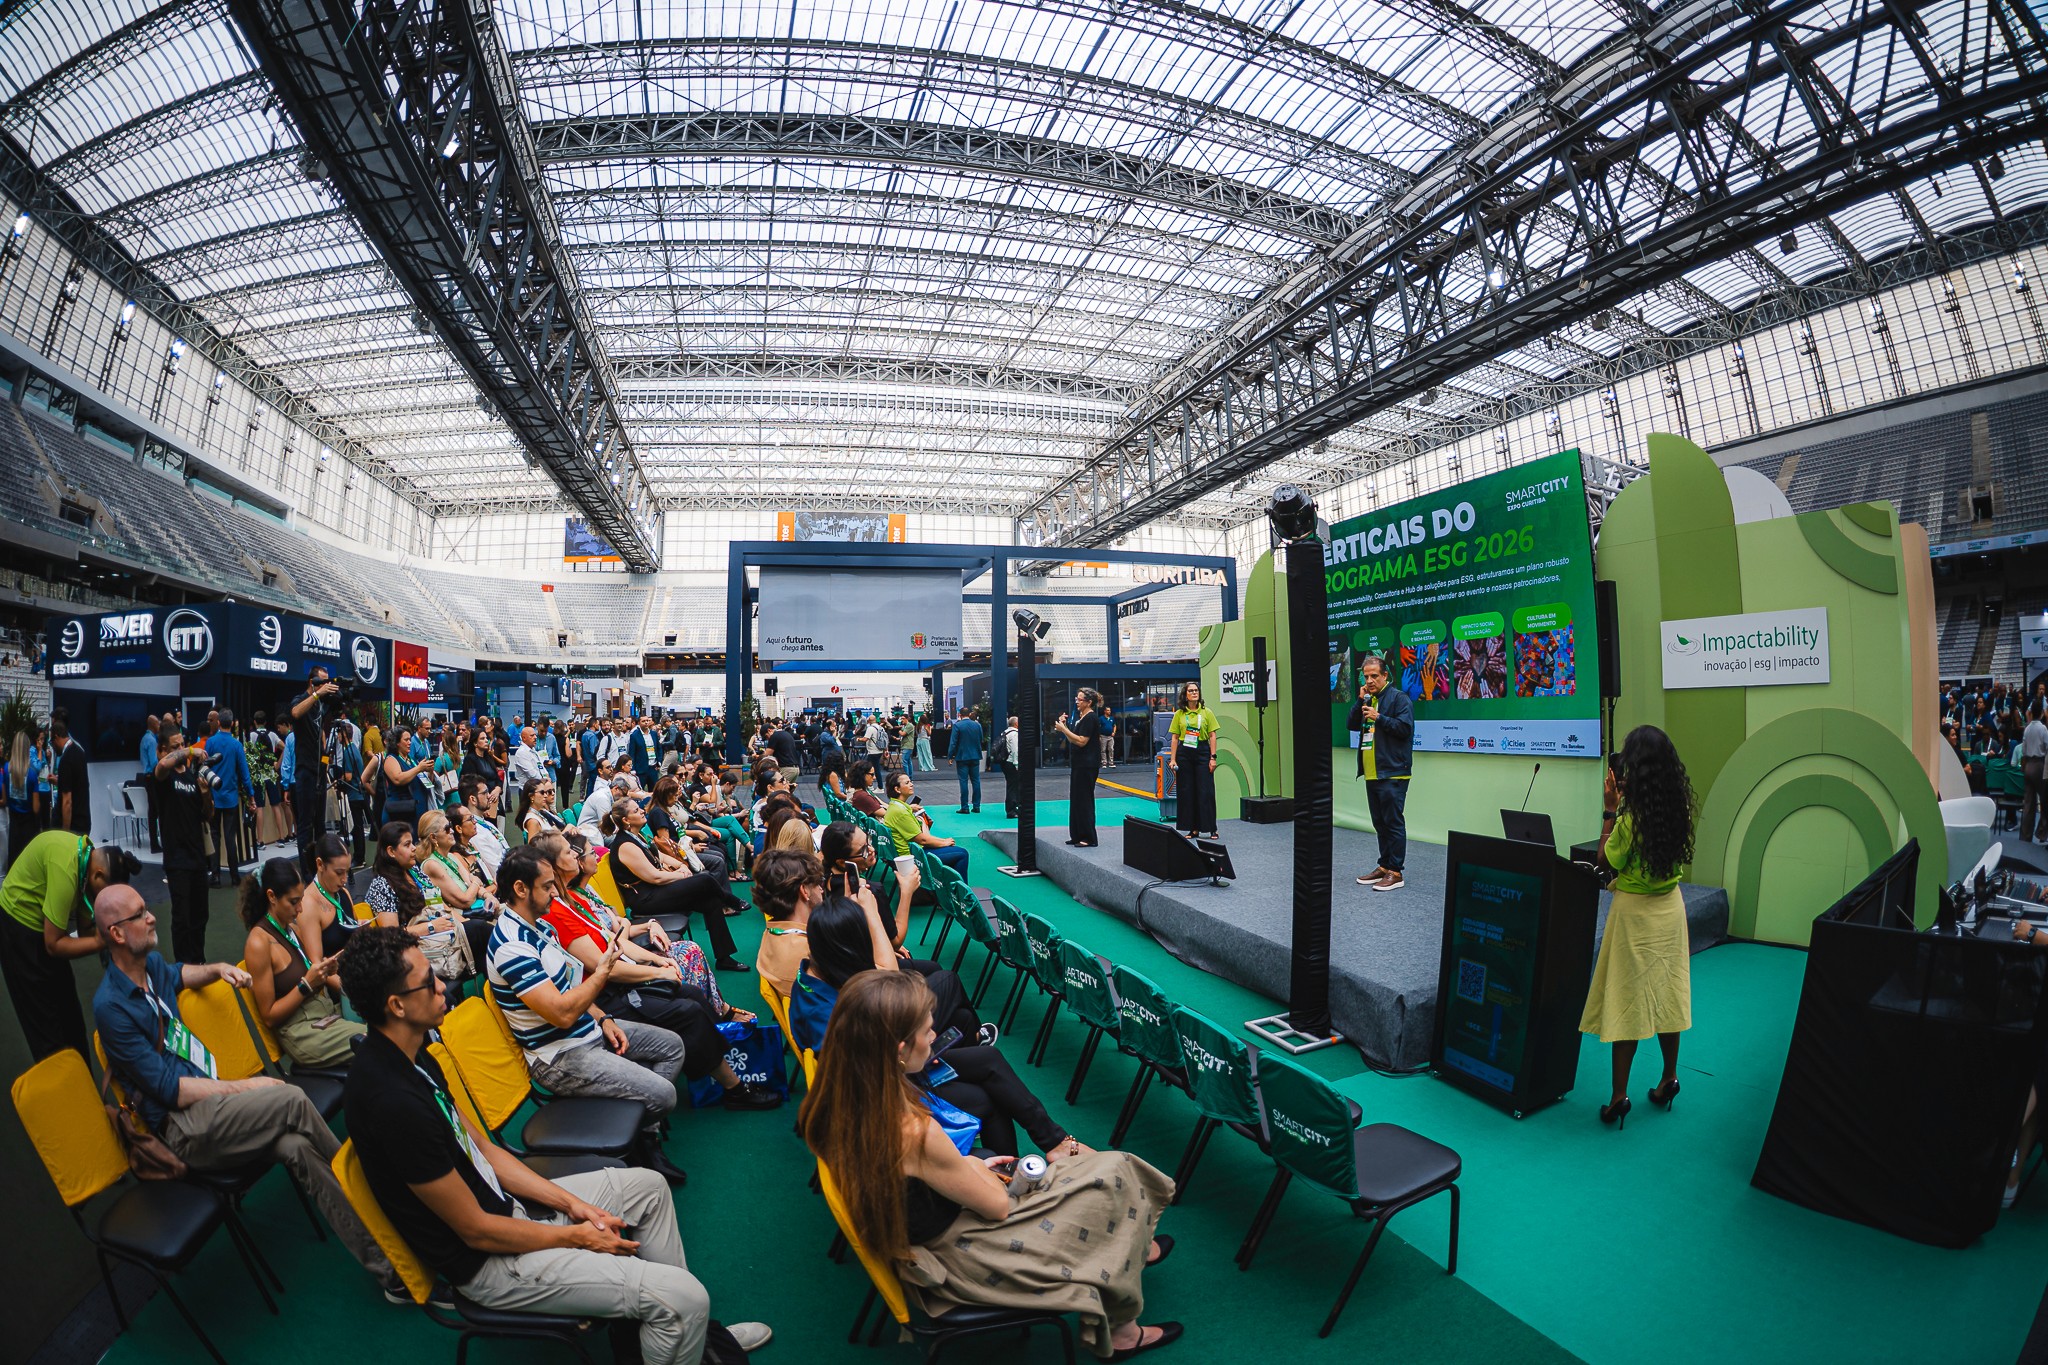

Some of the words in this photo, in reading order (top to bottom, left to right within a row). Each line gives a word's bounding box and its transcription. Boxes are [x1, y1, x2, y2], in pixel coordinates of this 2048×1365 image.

[1506, 476, 1569, 504] SMARTCITY
[1507, 503, 1521, 512] EXPO
[1522, 497, 1546, 508] CURITIBA
[1432, 501, 1476, 538] DO
[1424, 541, 1467, 573] ESG
[1474, 524, 1534, 564] 2026
[1133, 564, 1228, 586] CURITIBA
[1424, 580, 1446, 590] soluções
[1477, 568, 1514, 580] estruturamos
[1526, 562, 1543, 573] plano
[1545, 557, 1570, 568] robusto
[1397, 597, 1424, 607] consultivas
[1424, 595, 1436, 605] para
[1437, 592, 1457, 601] atender
[1466, 587, 1485, 596] evento
[1492, 583, 1512, 592] nossos
[1514, 575, 1561, 588] patrocinadores,
[1528, 620, 1556, 628] MOVIMENTO
[1703, 625, 1819, 655] Impactability
[53, 662, 89, 675] ESTEIO
[250, 657, 287, 672] ESTEIO
[1704, 659, 1747, 672] inovação
[1754, 659, 1771, 671] esg
[1778, 656, 1820, 668] impacto
[1222, 669, 1271, 685] SMARTCY
[1472, 882, 1523, 901] SMARTCITY
[1273, 1109, 1330, 1146] SMARTCITY
